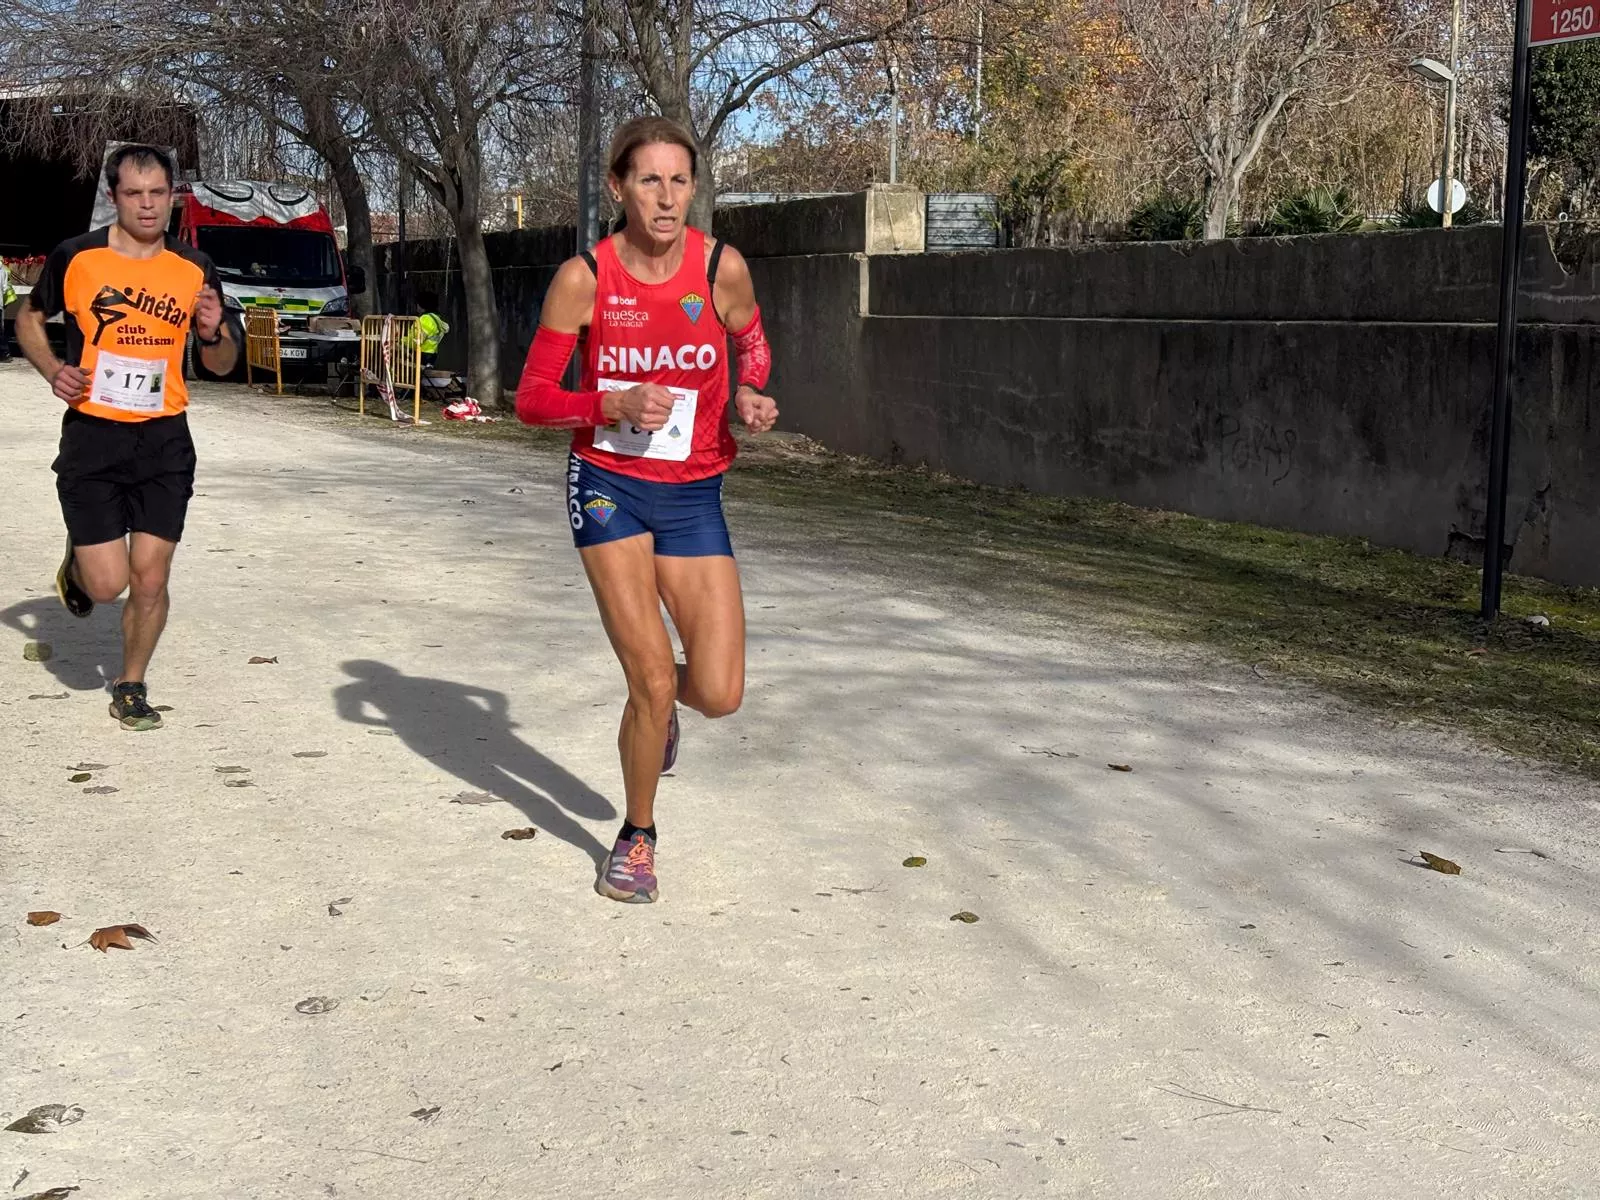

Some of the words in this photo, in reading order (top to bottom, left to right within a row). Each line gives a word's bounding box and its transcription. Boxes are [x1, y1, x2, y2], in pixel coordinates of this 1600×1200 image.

[1551, 5, 1594, 34] 1250
[117, 325, 146, 334] club
[117, 336, 175, 345] atletism
[122, 373, 146, 390] 17
